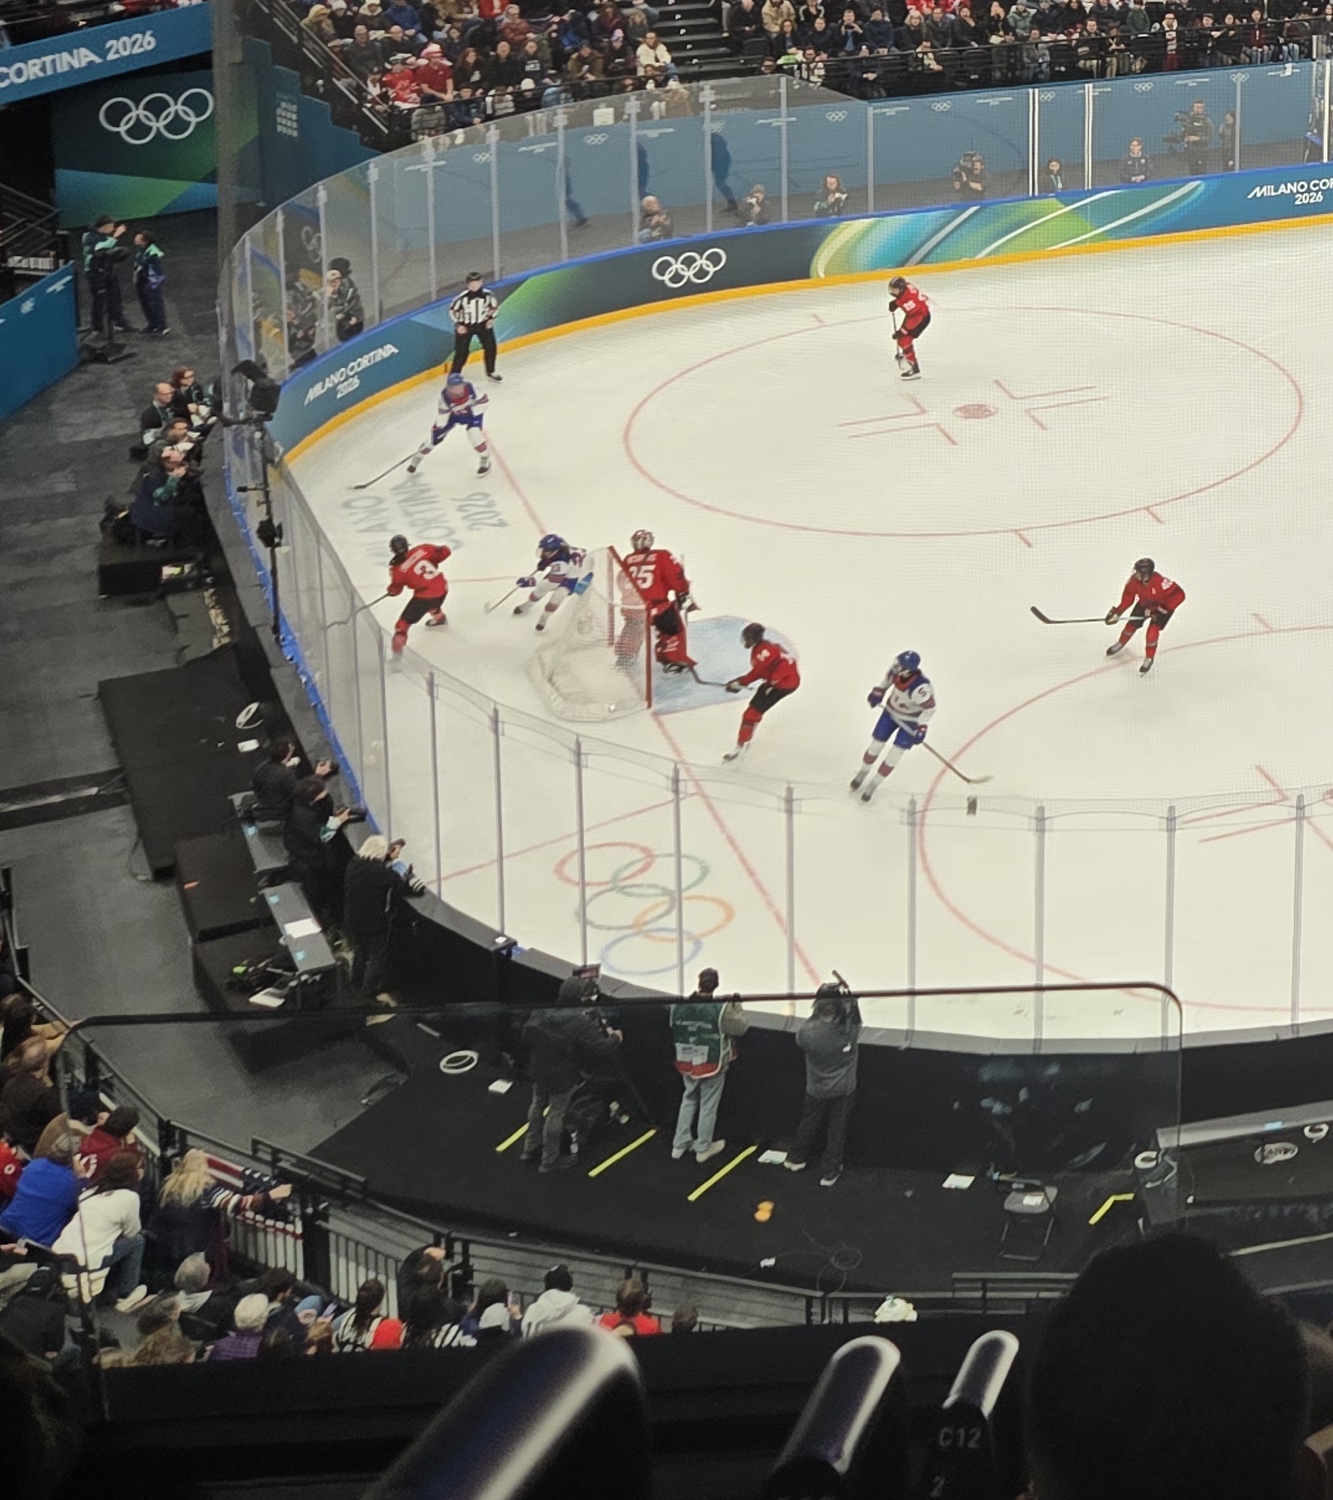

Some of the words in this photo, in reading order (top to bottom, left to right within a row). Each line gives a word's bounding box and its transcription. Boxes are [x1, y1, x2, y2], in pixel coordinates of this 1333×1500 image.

[105, 30, 157, 61] 2026
[1247, 182, 1307, 198] MILANO
[1294, 191, 1323, 204] 2026
[304, 367, 346, 406] MILANO
[347, 344, 399, 376] CORTINA
[450, 491, 510, 531] 2026
[414, 560, 438, 580] 3
